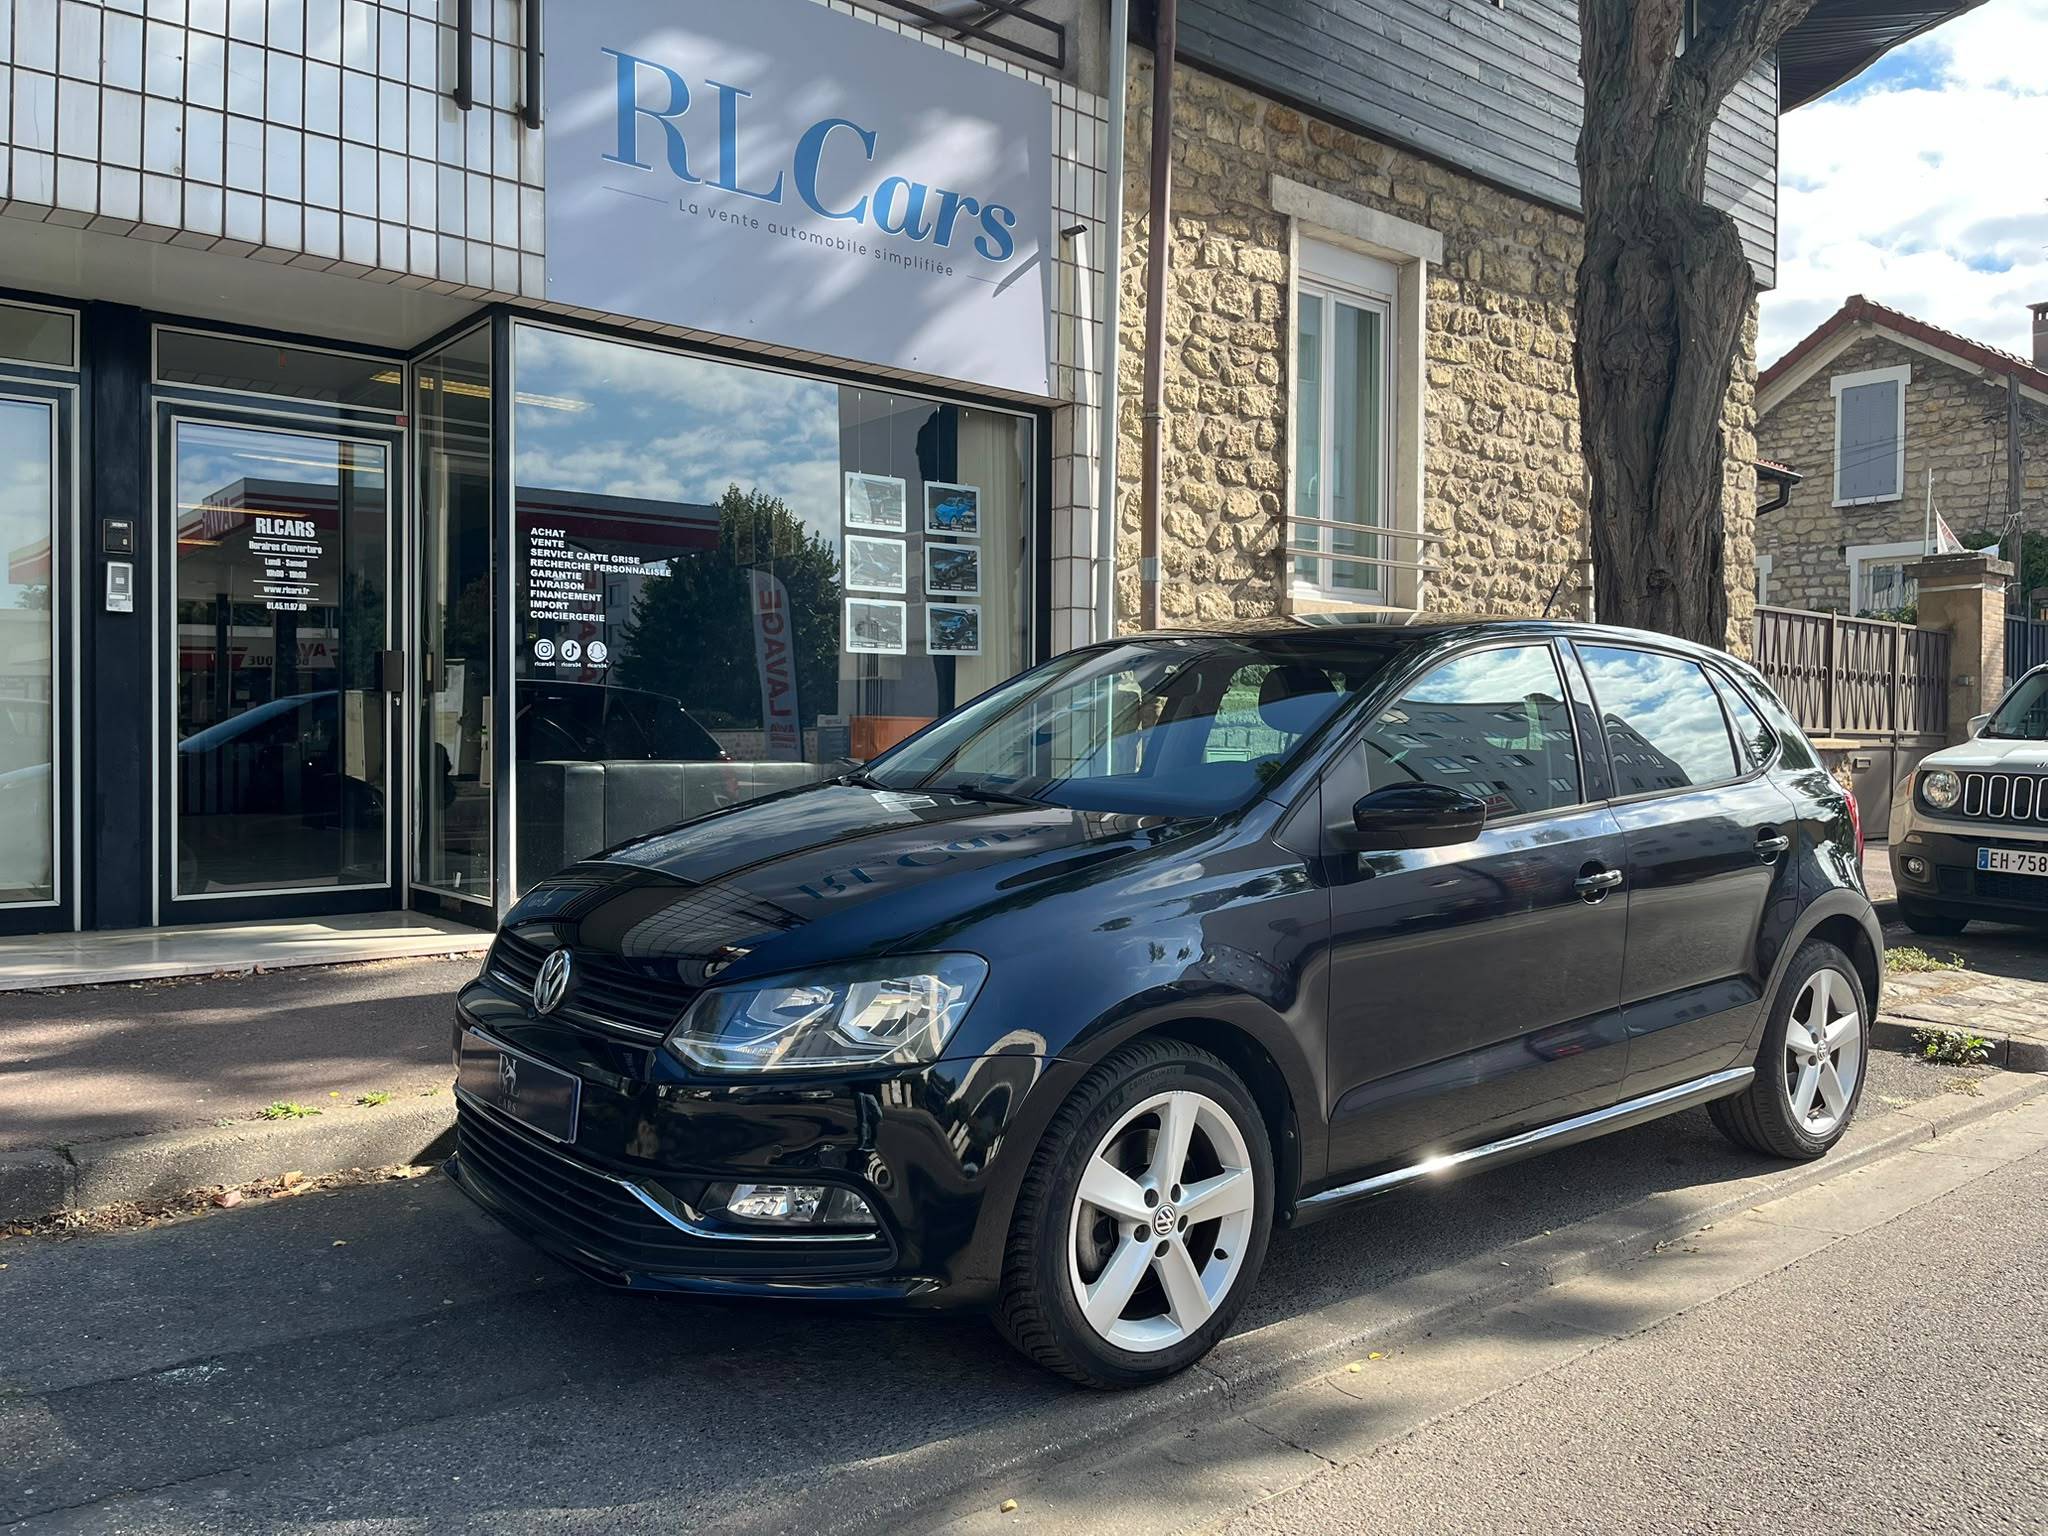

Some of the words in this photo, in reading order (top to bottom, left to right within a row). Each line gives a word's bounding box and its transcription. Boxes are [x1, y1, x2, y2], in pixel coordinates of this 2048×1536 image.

[679, 198, 699, 217] La
[707, 206, 760, 231] vente
[767, 219, 868, 257] automobile
[874, 247, 954, 278] simplifiée
[255, 517, 315, 538] RLCARS
[531, 528, 565, 538] ACHAT
[531, 538, 565, 548] VENTE
[531, 549, 573, 559] SERVICE
[576, 552, 608, 562] CARTE
[611, 555, 640, 564] GRISE
[530, 559, 591, 571] RECHERCHE
[530, 569, 582, 580] GARANTIE
[530, 579, 584, 590] LIVRAISON
[530, 590, 602, 601] FINANCEMENT
[530, 600, 569, 609] IMPORT
[530, 611, 605, 622] CONCIERGERIE
